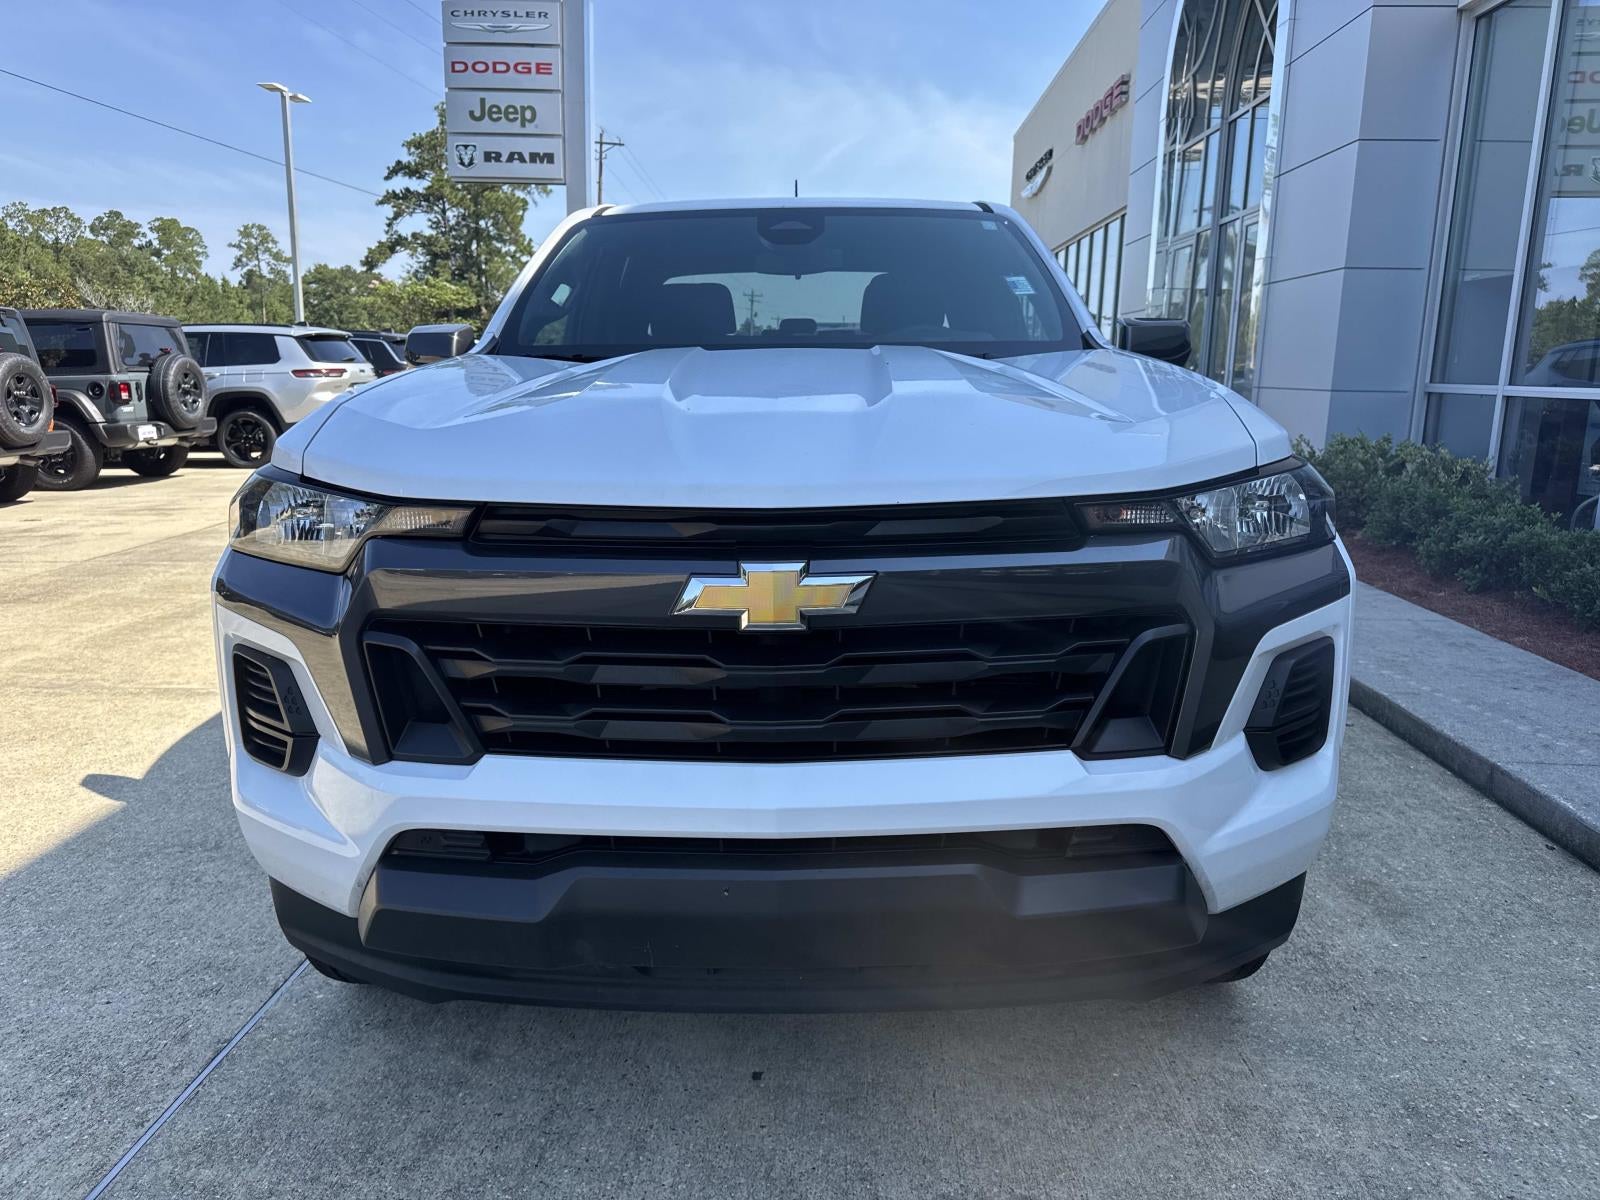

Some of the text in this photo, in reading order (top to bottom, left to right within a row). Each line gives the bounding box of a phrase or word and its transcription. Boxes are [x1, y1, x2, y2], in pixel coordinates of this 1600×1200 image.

[450, 9, 549, 19] CHRYSLER
[450, 61, 553, 75] DODGE
[468, 97, 537, 128] Jeep
[1075, 73, 1131, 145] DODGE
[483, 151, 555, 164] RAM
